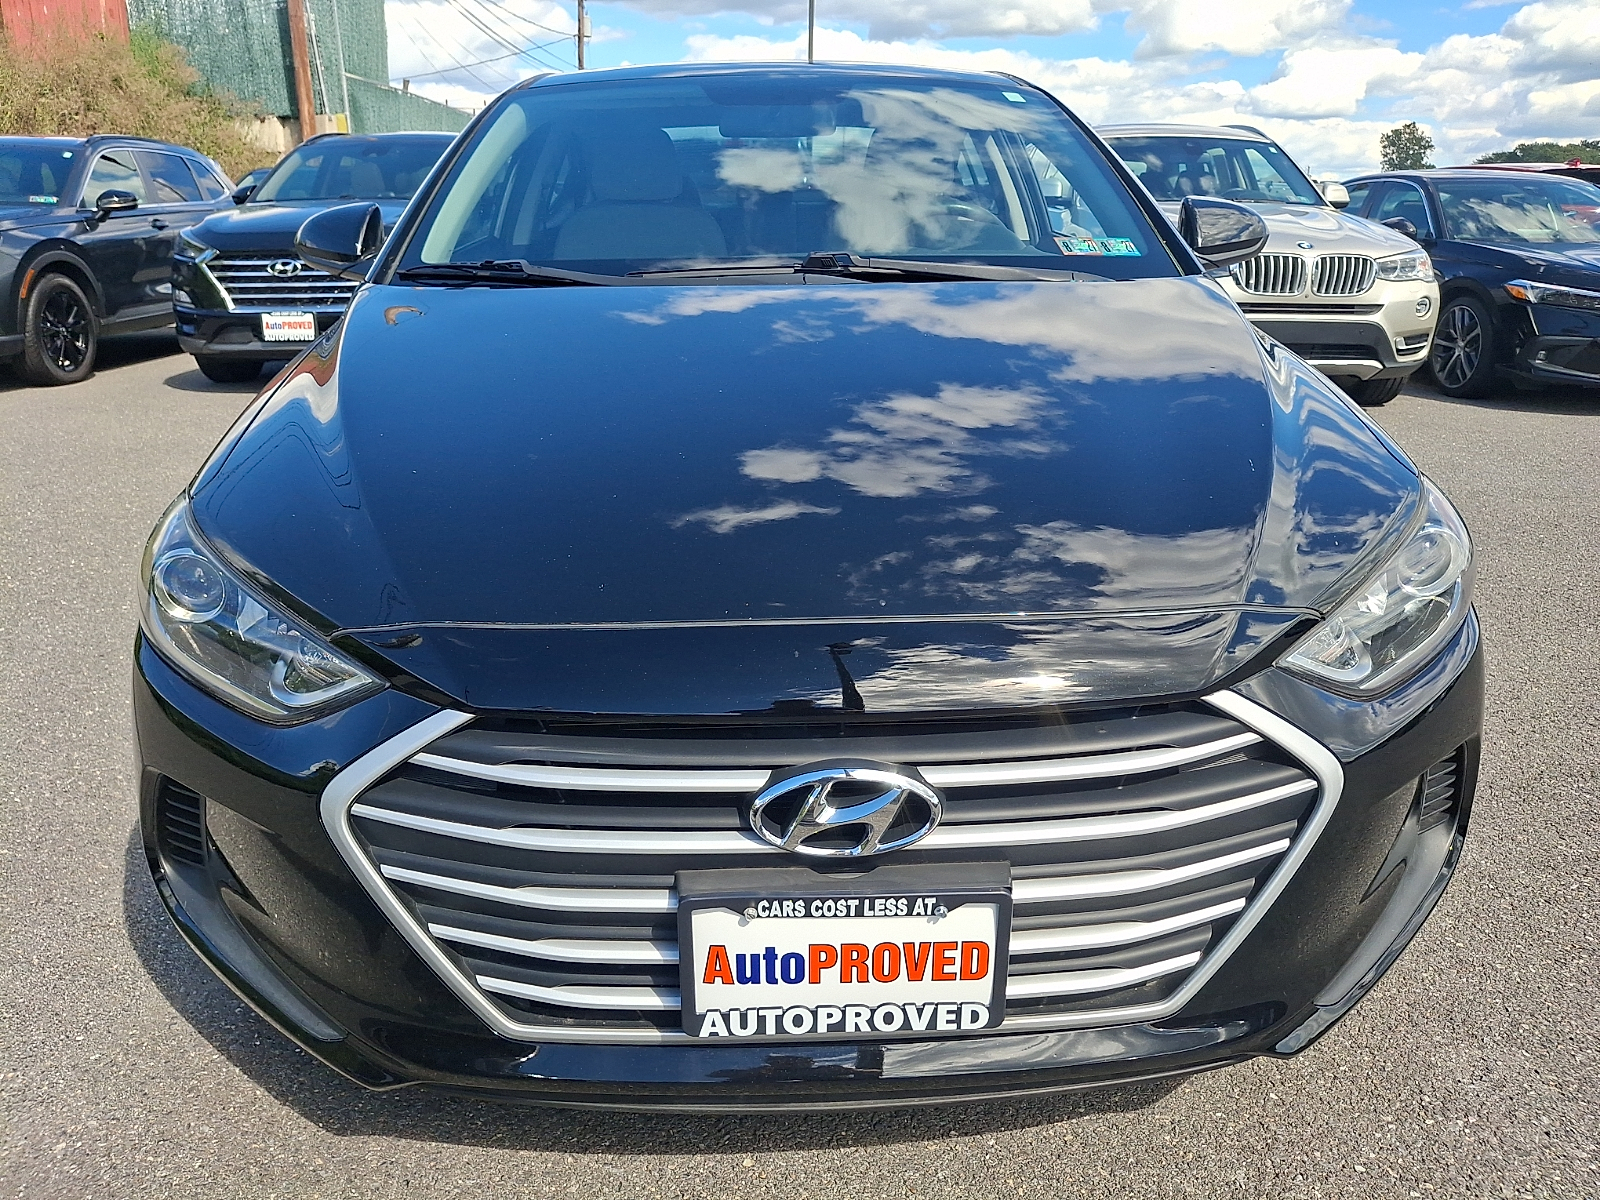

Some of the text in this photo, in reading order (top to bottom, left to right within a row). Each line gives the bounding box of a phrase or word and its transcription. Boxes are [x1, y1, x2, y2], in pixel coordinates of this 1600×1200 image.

[1062, 241, 1073, 253] 8
[1100, 241, 1112, 253] 8
[265, 321, 313, 330] AutoPROVED
[264, 333, 315, 342] AUTOPROVED
[757, 897, 937, 918] CARS COST LESS AT
[702, 940, 990, 985] AutoPROVED
[698, 1001, 990, 1038] AUTOPROVED
